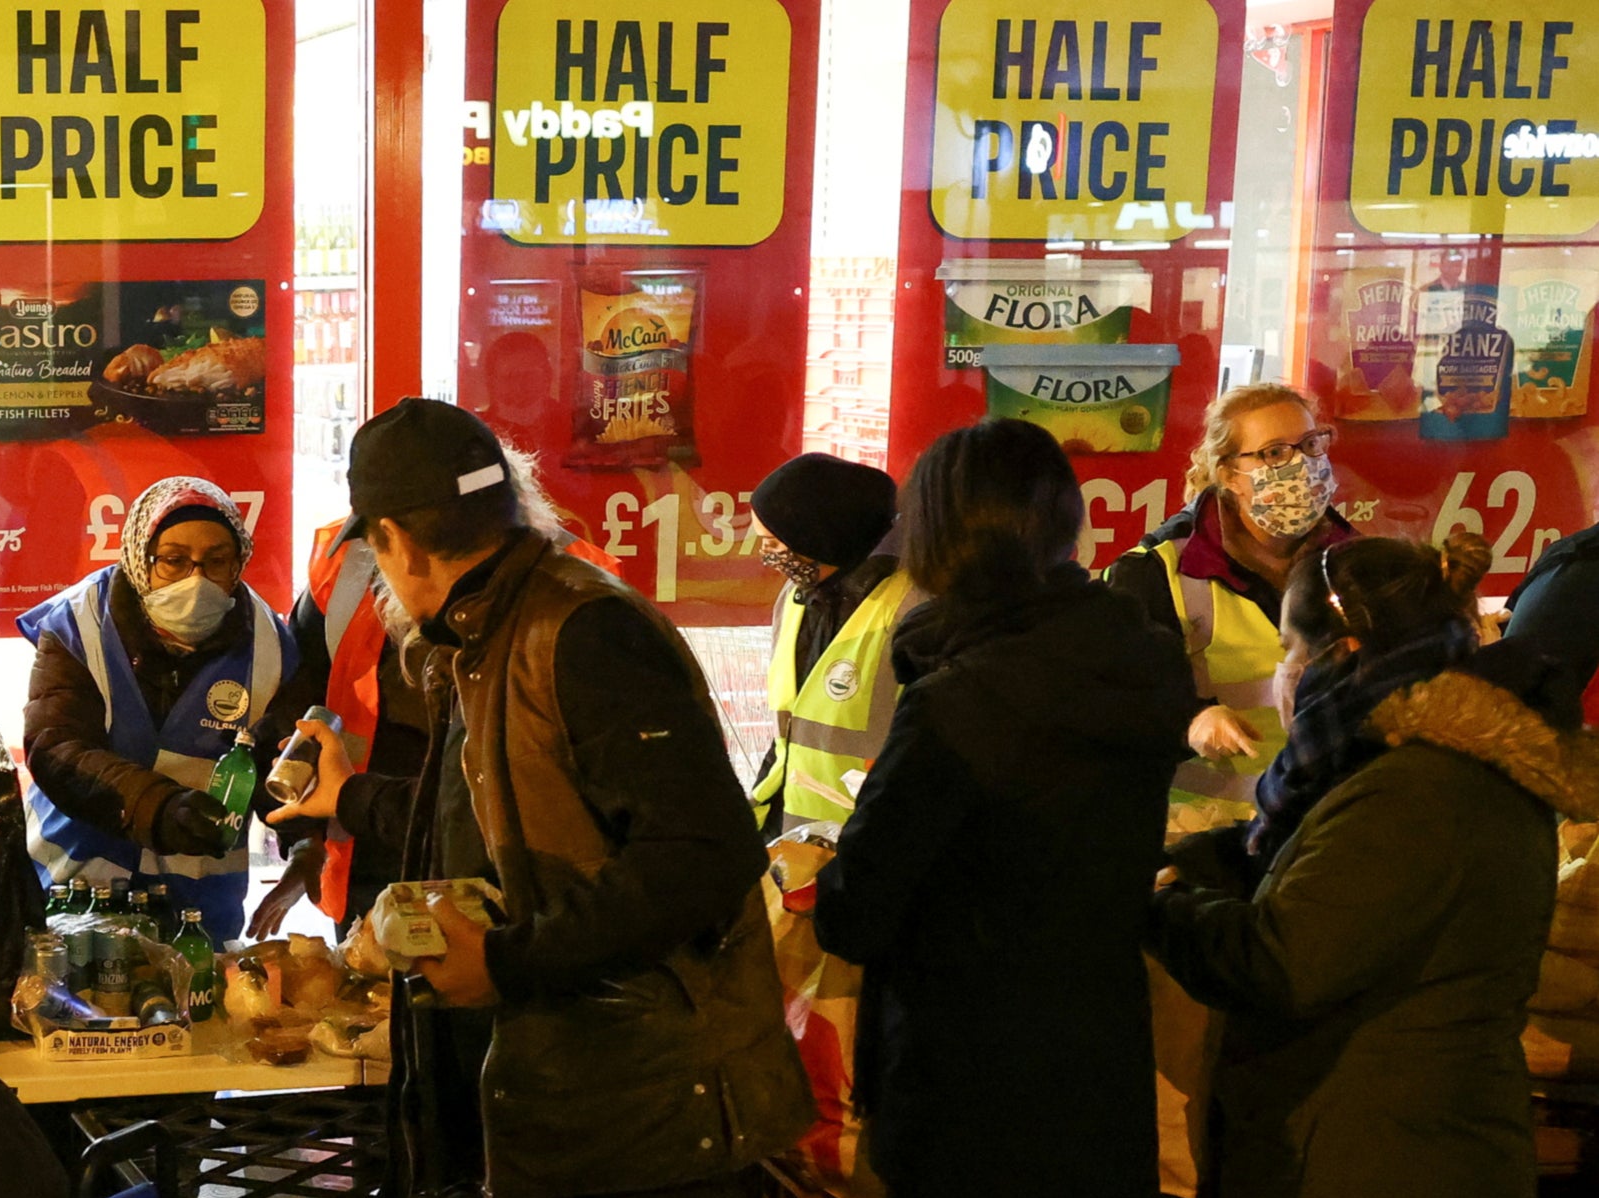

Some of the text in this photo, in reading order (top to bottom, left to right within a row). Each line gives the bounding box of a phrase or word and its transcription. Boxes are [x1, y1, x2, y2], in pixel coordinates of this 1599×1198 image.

[16, 9, 201, 94] HALF
[554, 20, 729, 103] HALF
[992, 19, 1161, 102] HALF
[1410, 20, 1573, 99] HALF
[0, 114, 217, 199] PRICE
[535, 124, 741, 206] PRICE
[971, 120, 1170, 201] PRICE
[1387, 118, 1577, 197] PRICE
[1006, 284, 1073, 298] ORIGINAL
[16, 300, 52, 316] Young's
[983, 294, 1100, 330] FLORA
[605, 326, 668, 349] McCain
[1438, 333, 1502, 357] BEANZ
[37, 360, 93, 379] Breaded
[948, 350, 982, 367] 500g
[47, 390, 83, 399] PEPPER
[1030, 374, 1136, 403] FLORA
[0, 408, 71, 419] FISH FILLETS
[603, 391, 670, 420] FRIES
[69, 1036, 112, 1048] NATURAL
[115, 1034, 150, 1047] ENERGY
